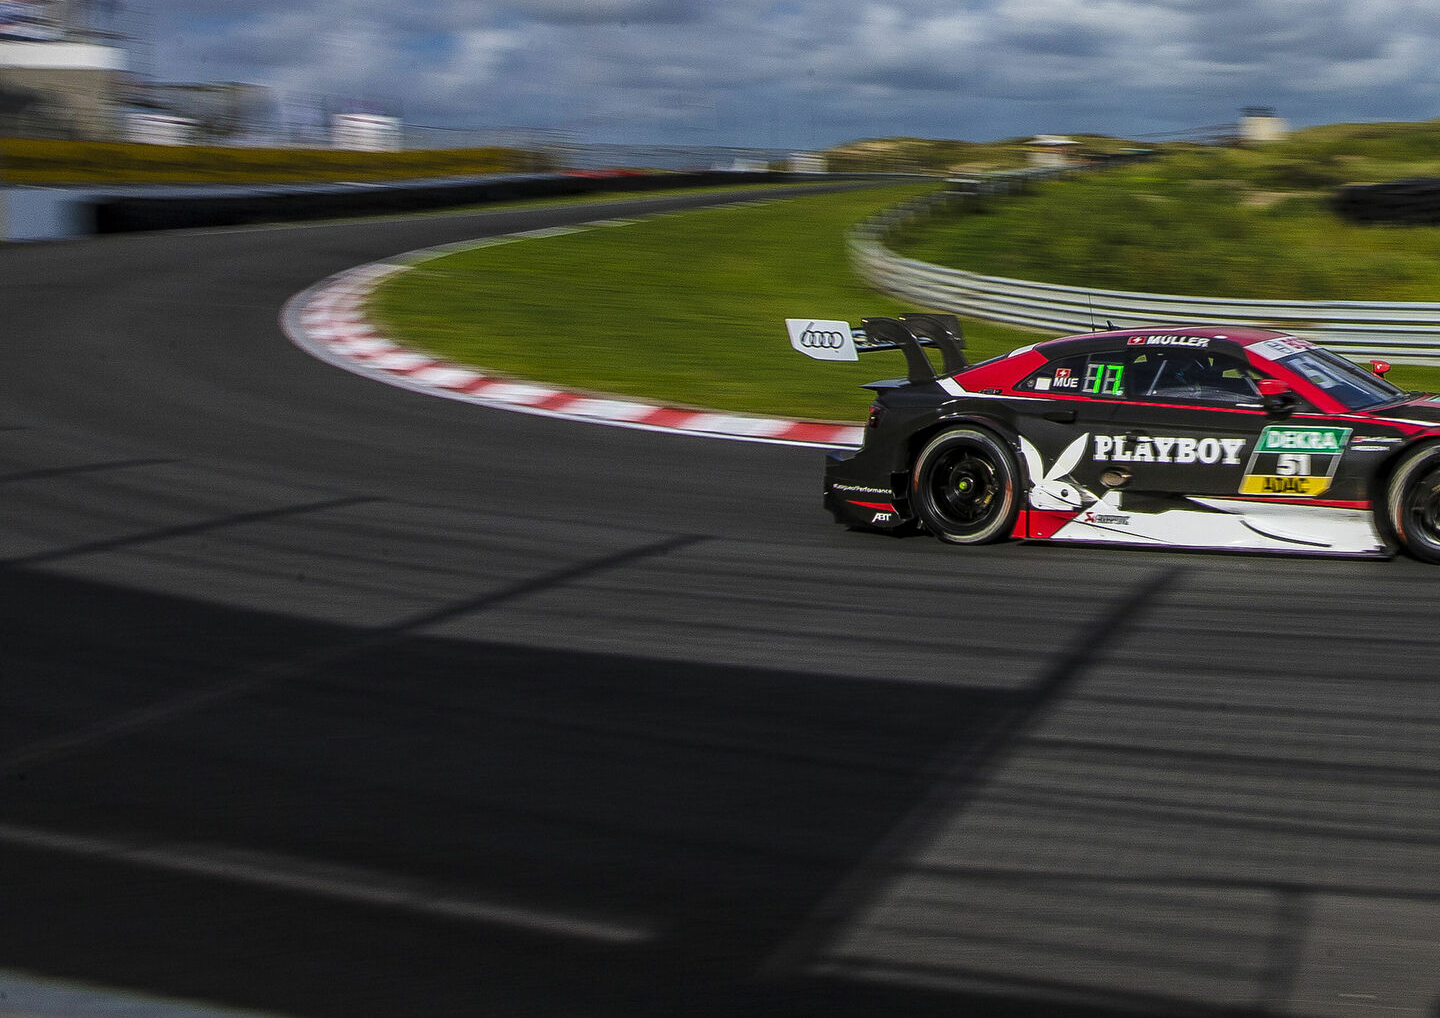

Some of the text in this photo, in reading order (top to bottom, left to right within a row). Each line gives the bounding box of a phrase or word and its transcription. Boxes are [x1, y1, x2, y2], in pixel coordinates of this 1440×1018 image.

[1146, 335, 1210, 348] MÜLLER
[1053, 377, 1079, 388] MUE
[1092, 364, 1124, 395] 17
[1093, 435, 1247, 465] PLAYBOY
[1266, 431, 1340, 449] DEKRA
[1276, 453, 1311, 476] 51
